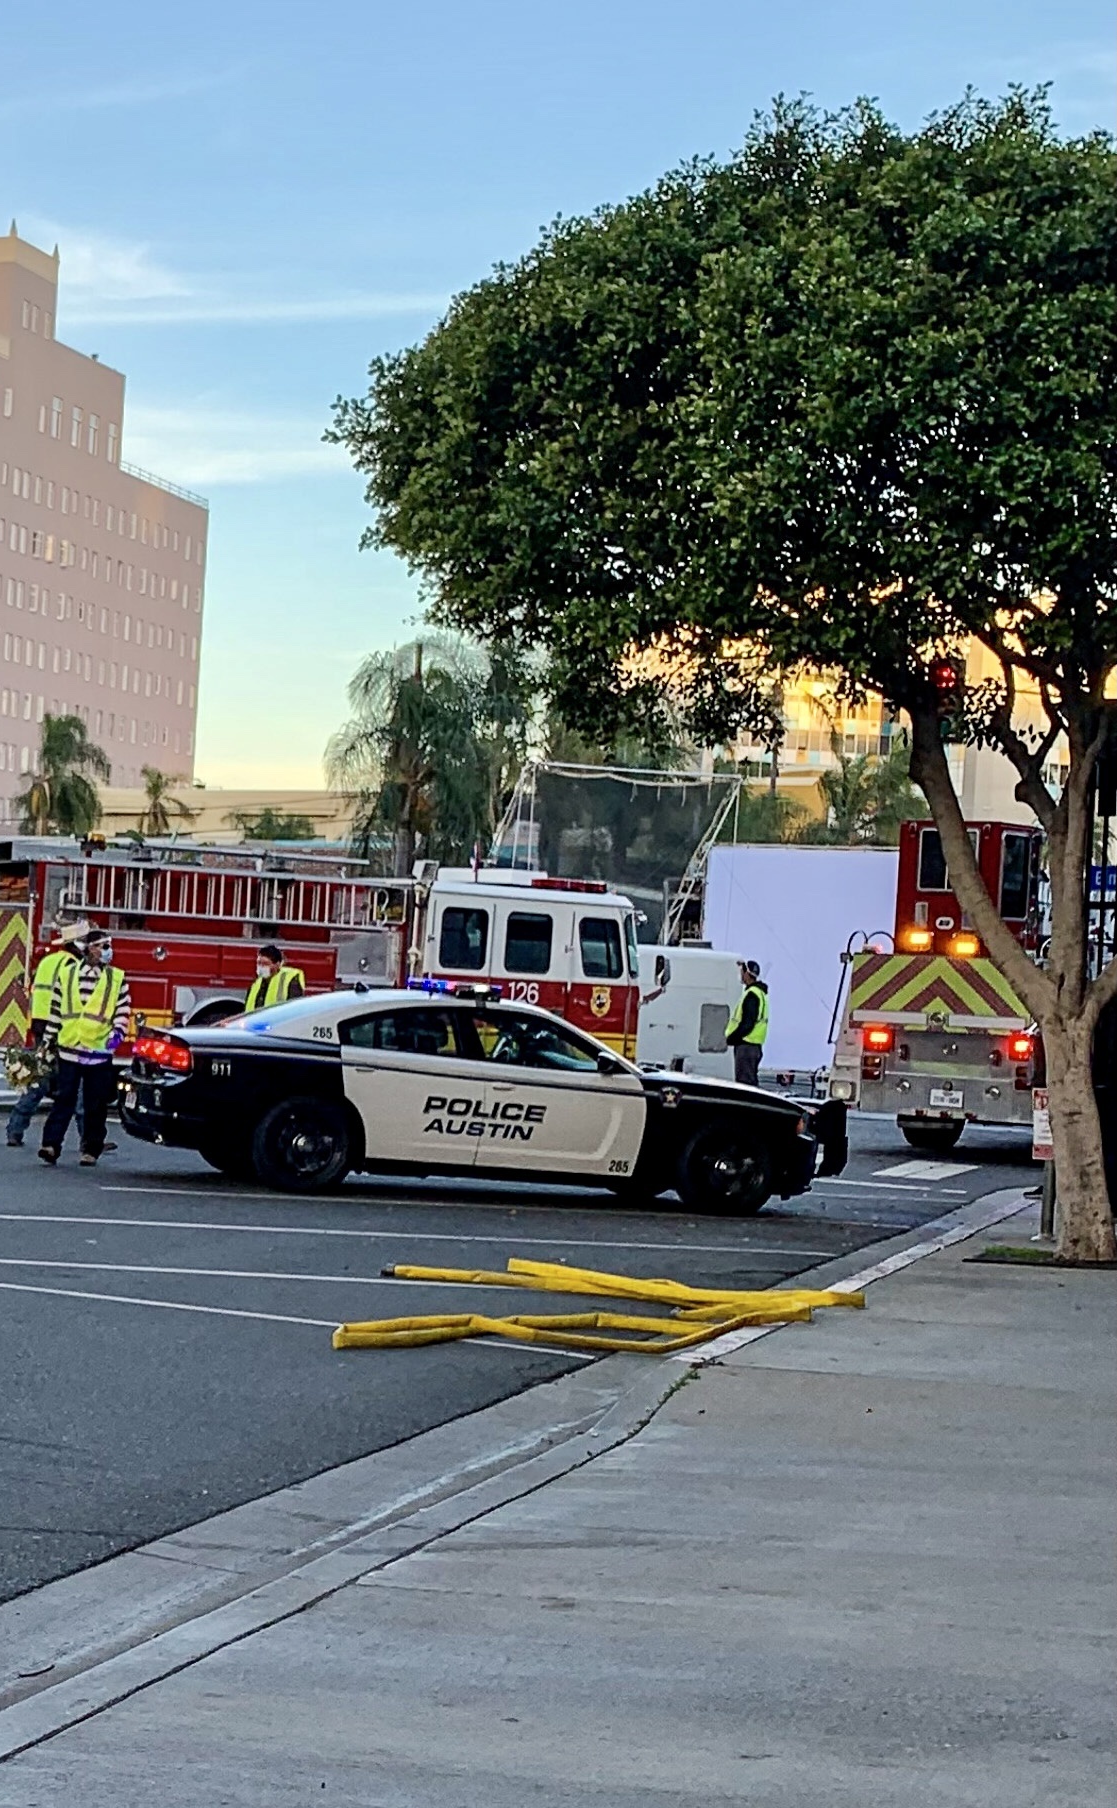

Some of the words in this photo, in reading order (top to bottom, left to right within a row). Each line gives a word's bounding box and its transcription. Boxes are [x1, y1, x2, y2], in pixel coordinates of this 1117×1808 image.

[508, 981, 539, 1004] 126
[312, 1025, 333, 1040] 265
[211, 1062, 231, 1076] 911
[423, 1095, 547, 1123] POLICE
[423, 1118, 534, 1141] AUSTIN
[608, 1159, 629, 1174] 265
